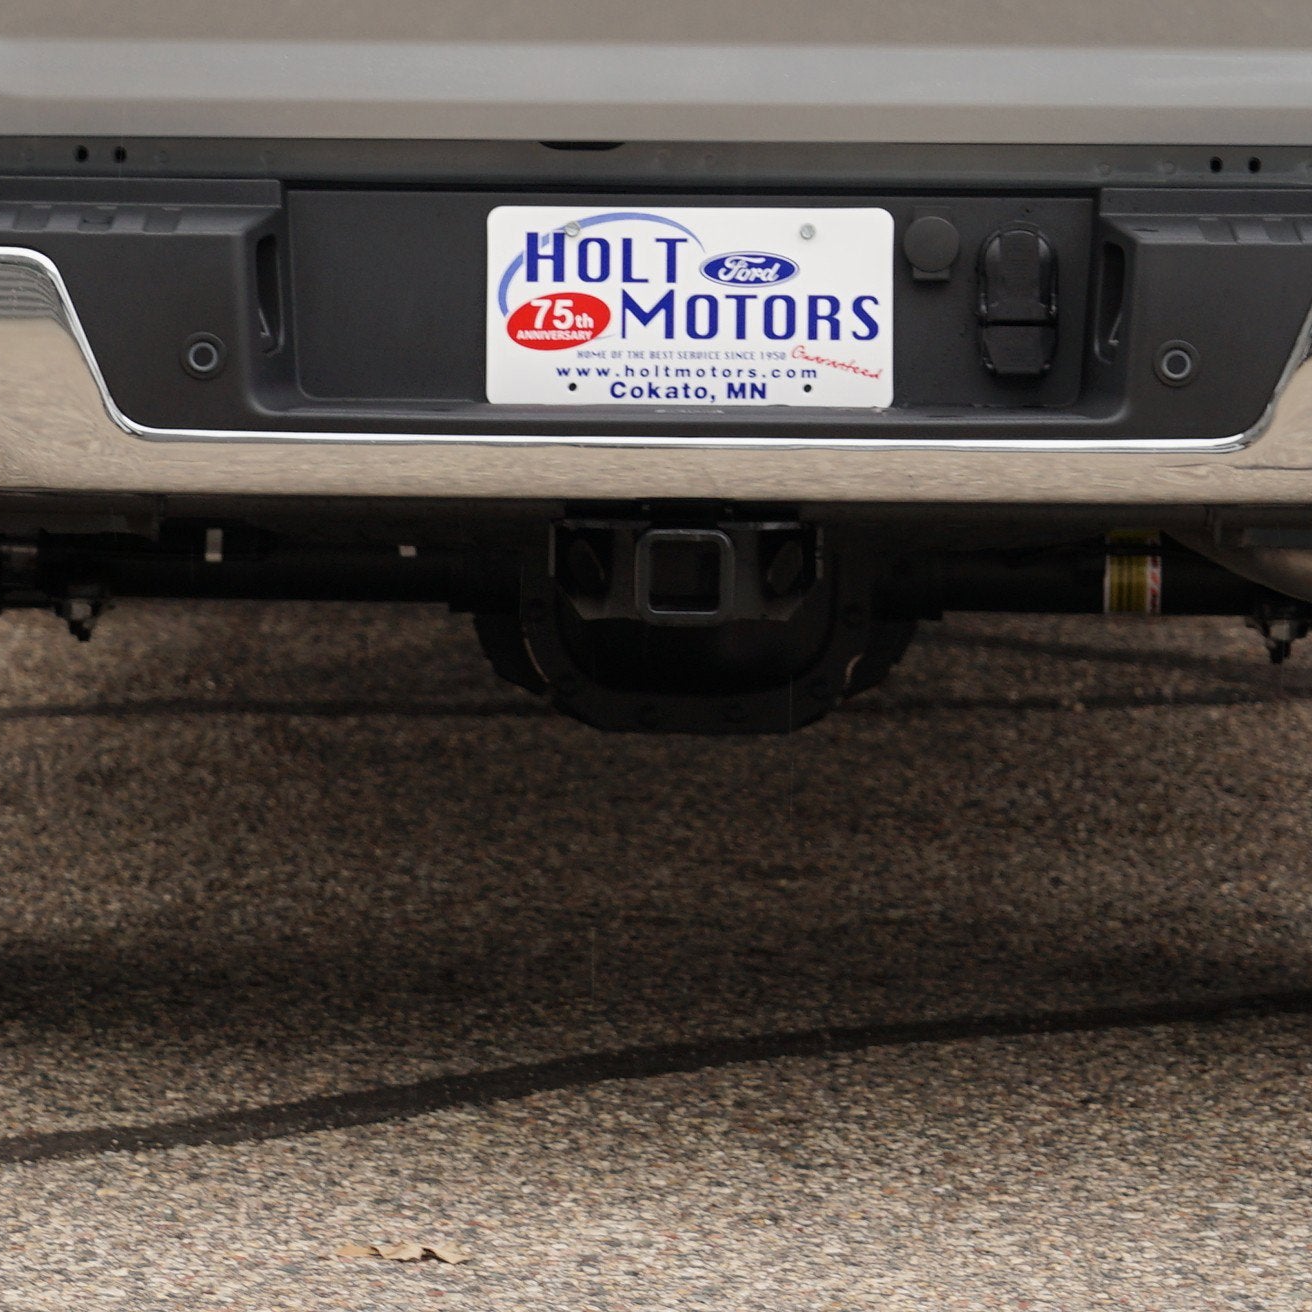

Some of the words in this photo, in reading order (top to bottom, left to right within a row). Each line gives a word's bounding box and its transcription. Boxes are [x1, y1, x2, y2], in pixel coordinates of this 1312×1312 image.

[525, 231, 688, 283] HOLT
[717, 256, 780, 282] Ford
[529, 298, 595, 331] 75th
[621, 288, 880, 341] MOTORS
[515, 330, 593, 341] ANNIVERSARY
[577, 350, 607, 360] HOME
[611, 350, 623, 360] OF
[627, 350, 646, 360] THE
[649, 350, 675, 360] BEST
[677, 350, 721, 360] SERVICE
[724, 350, 758, 361] SINCE
[555, 365, 818, 379] www.holtmotors.com
[609, 381, 716, 403] Cokato,
[726, 382, 767, 399] MN
